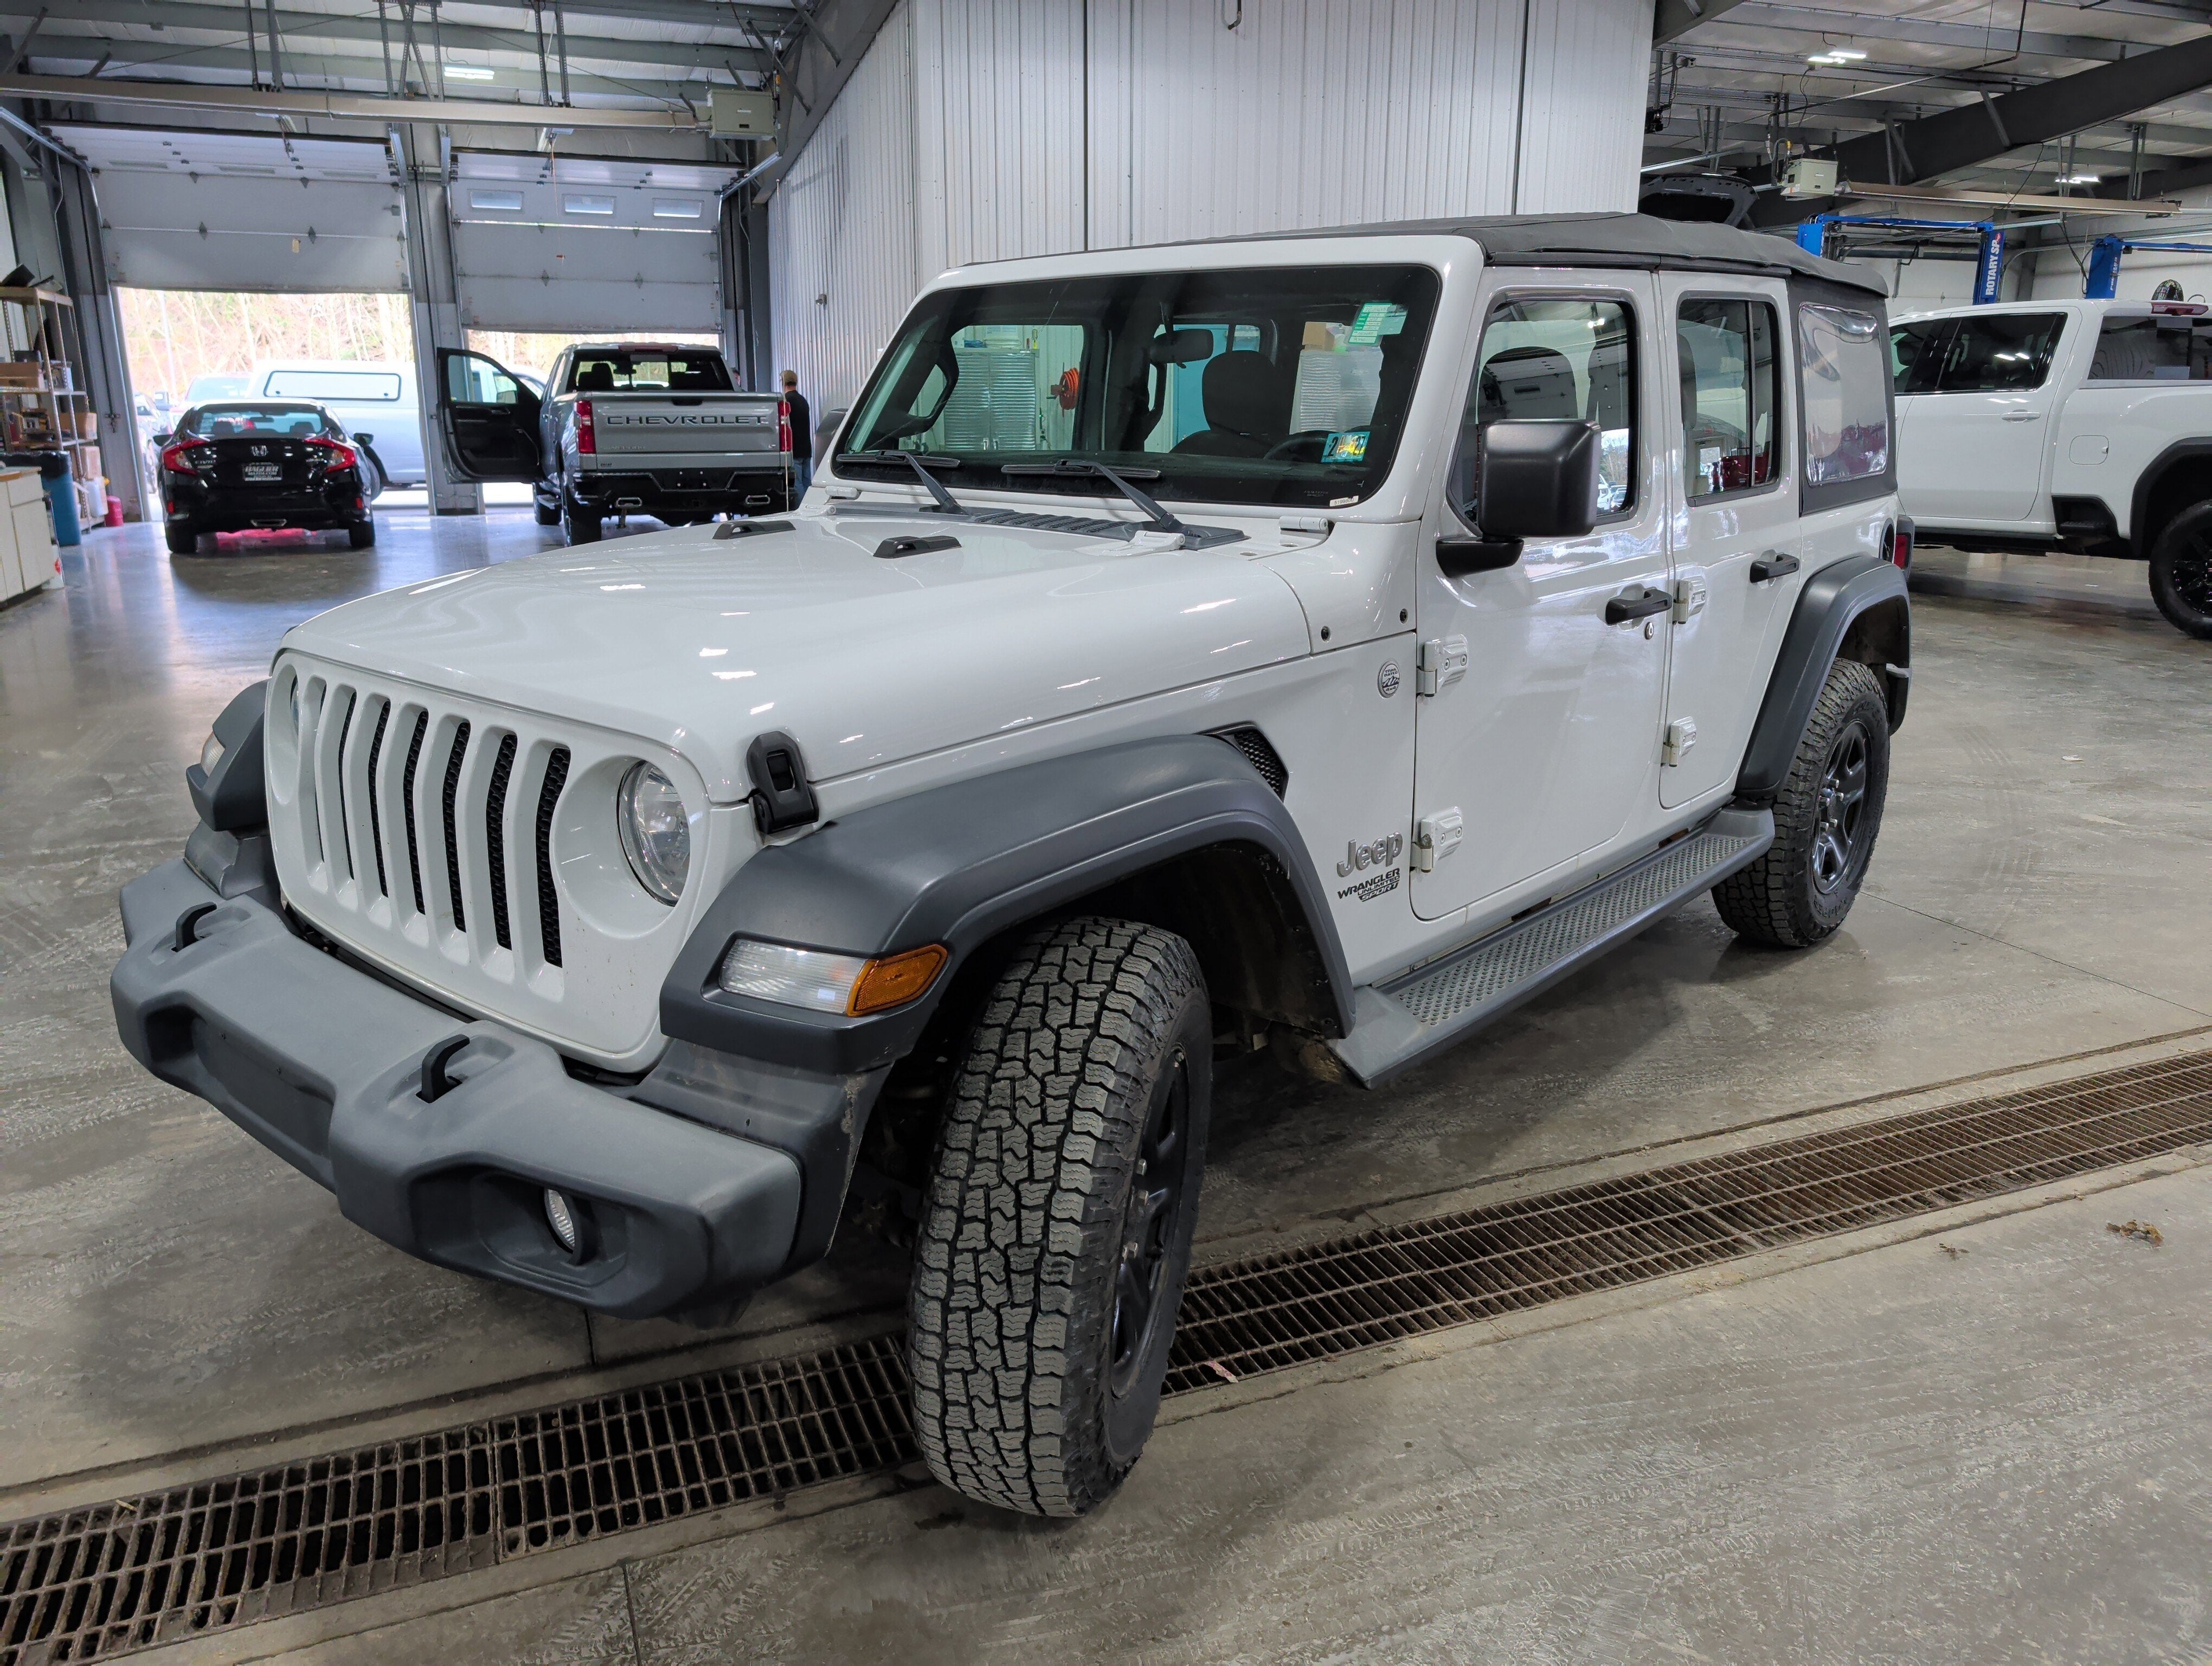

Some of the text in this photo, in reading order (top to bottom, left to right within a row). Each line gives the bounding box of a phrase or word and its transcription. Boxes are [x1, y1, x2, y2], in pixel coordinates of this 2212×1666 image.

[1985, 255, 1998, 296] ROTARY
[607, 415, 767, 425] CHEVROLET
[1337, 831, 1403, 877] Jeep
[1338, 868, 1400, 899] WRANGLER
[1358, 875, 1400, 896] UNLIMITED
[1360, 882, 1399, 900] SPORT
